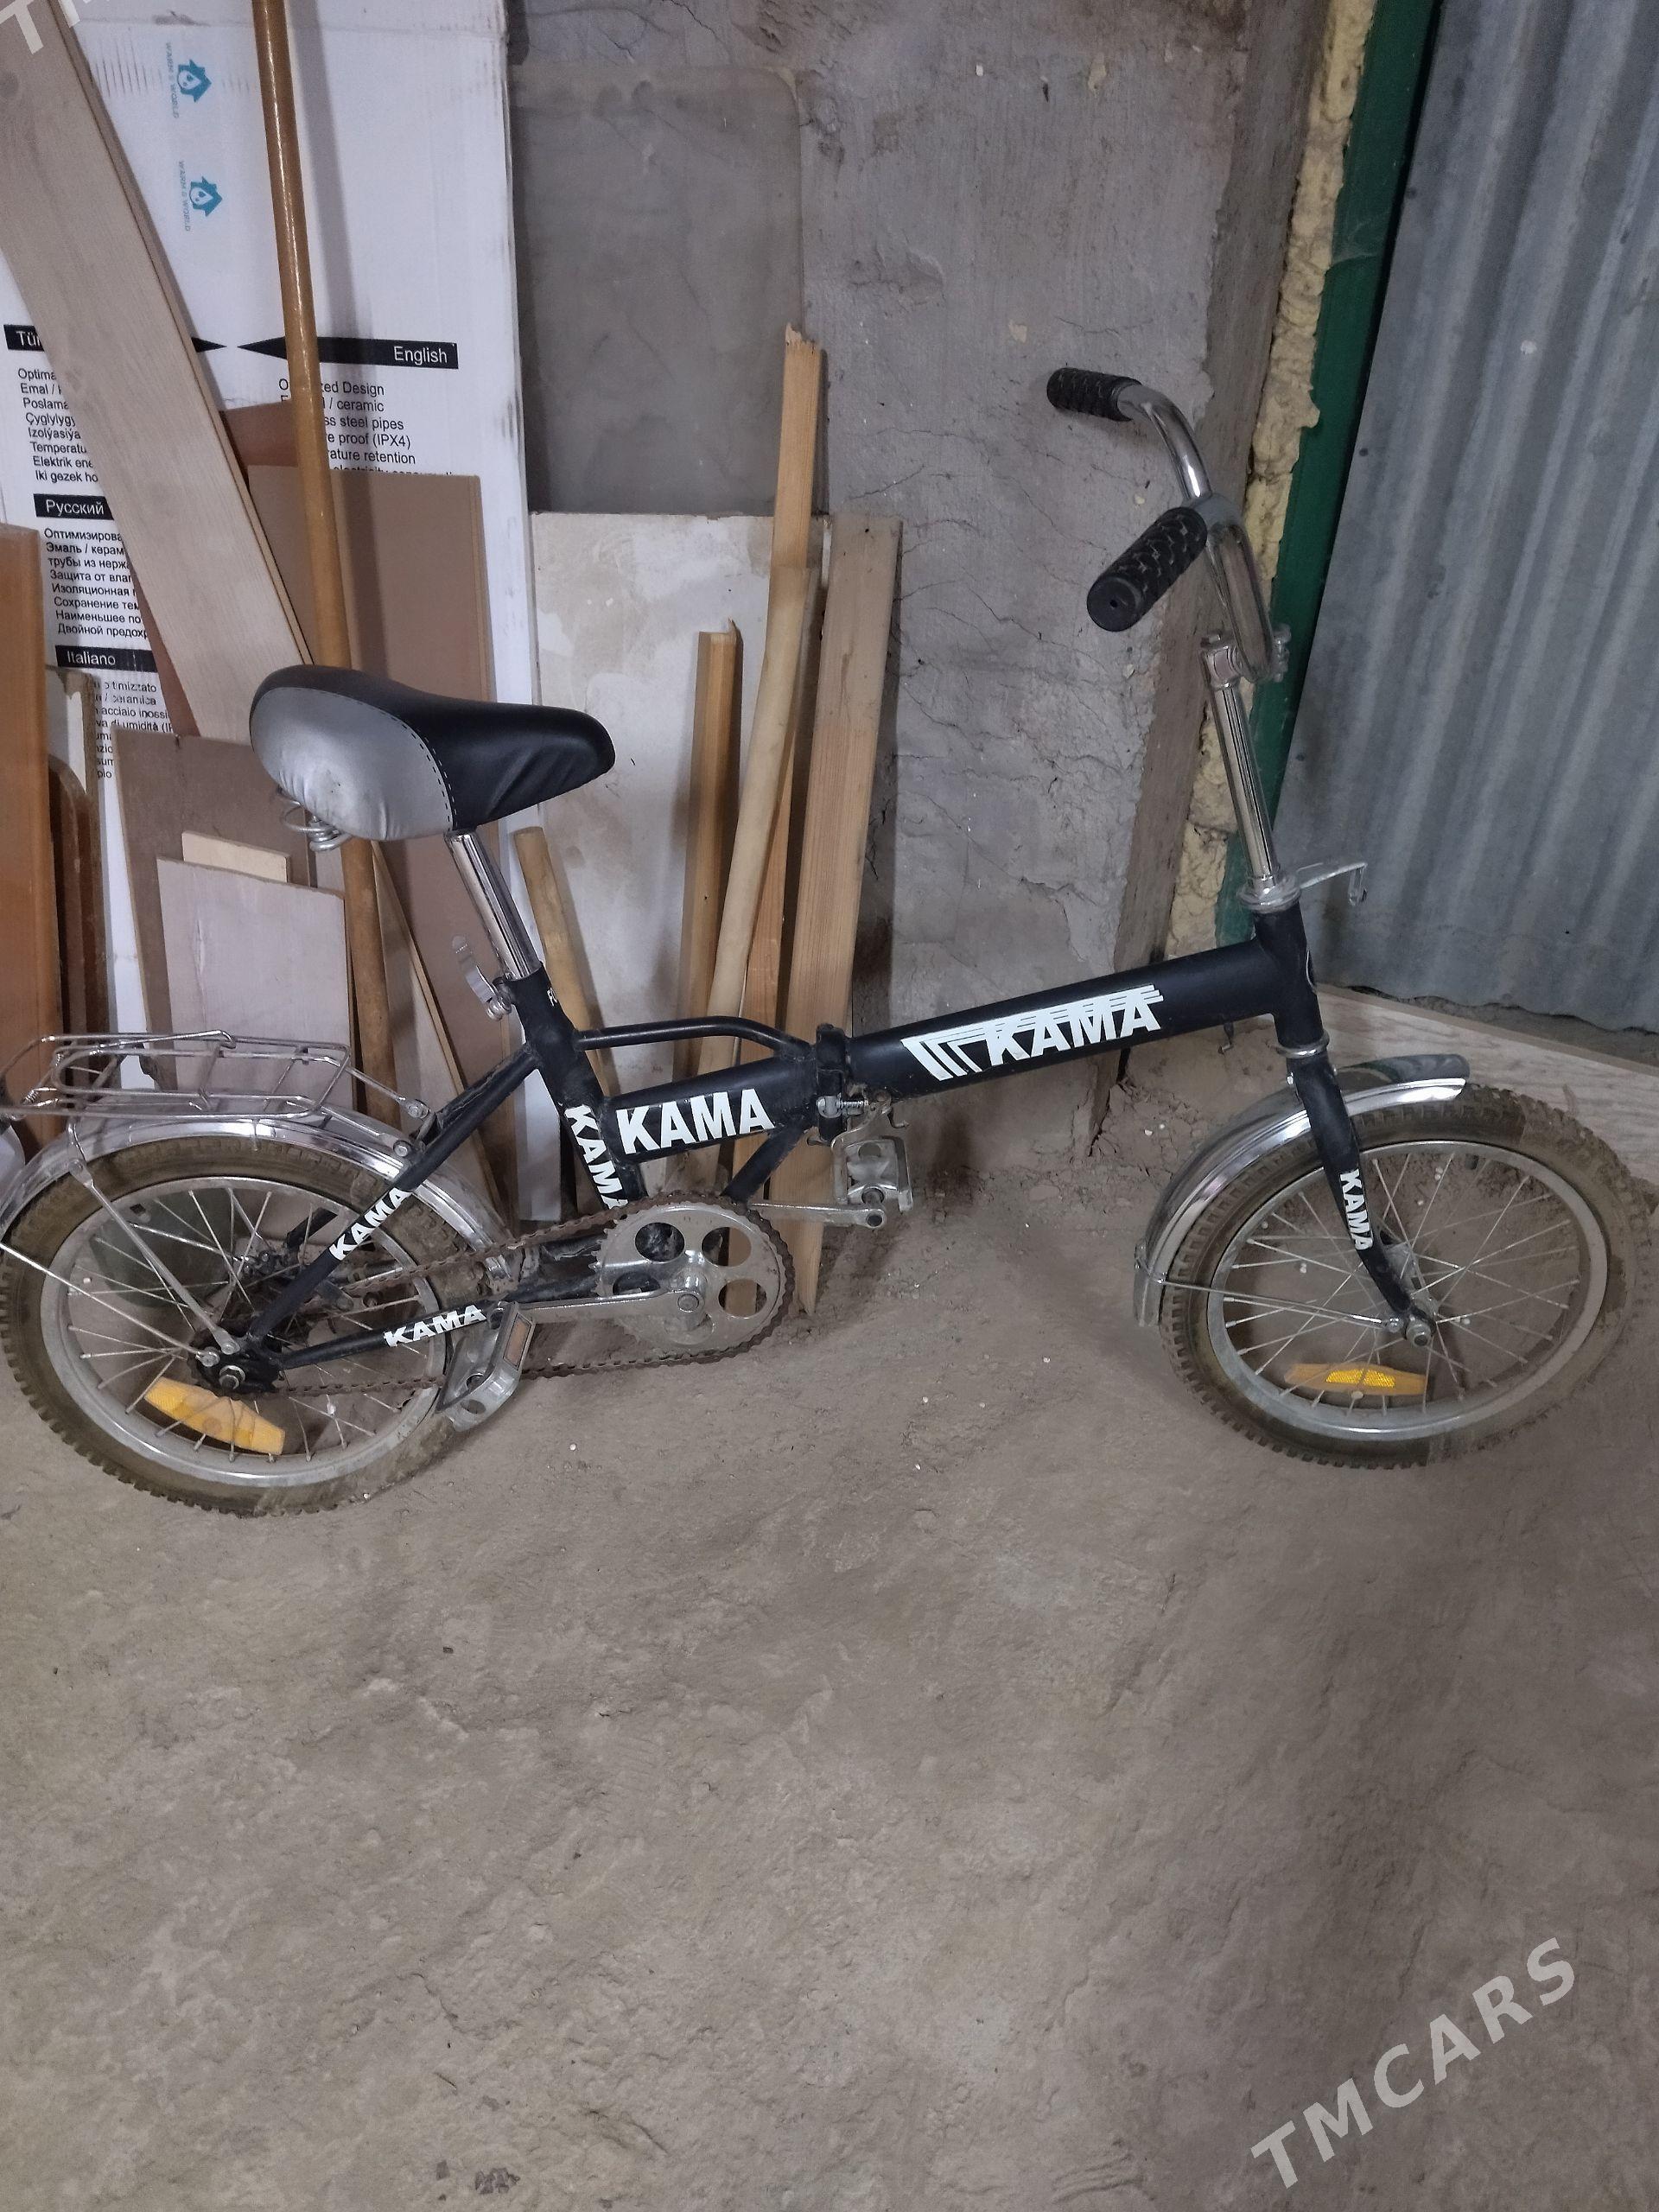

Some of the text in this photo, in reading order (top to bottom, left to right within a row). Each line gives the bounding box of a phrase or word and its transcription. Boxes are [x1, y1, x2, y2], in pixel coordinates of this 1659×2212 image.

[393, 346, 448, 365] English
[20, 383, 48, 394] Emal
[342, 381, 385, 397] Design
[337, 399, 385, 412] ceramic
[340, 416, 368, 429] steel
[372, 417, 404, 430] pipes
[339, 433, 369, 447] proof
[372, 435, 411, 450] (IPX4)
[33, 455, 72, 467] Elektrik
[364, 451, 416, 464] retention
[50, 471, 83, 484] gezek
[46, 499, 105, 518] Русский
[46, 542, 82, 554] Эмаль
[48, 556, 81, 568] трубы
[50, 569, 92, 582] Защита
[52, 583, 130, 597] Изоляционная
[54, 596, 119, 610] Сохранение
[55, 610, 125, 623] Наименьшее
[58, 623, 104, 635] Двойной
[67, 651, 116, 665] Italiano
[101, 707, 137, 717] acciaio
[983, 985, 1163, 1066] KAMA
[616, 1089, 776, 1154] KAMA
[1340, 1168, 1374, 1250] KAMA
[329, 1187, 412, 1261] KAMA
[384, 1305, 487, 1347] KAMA
